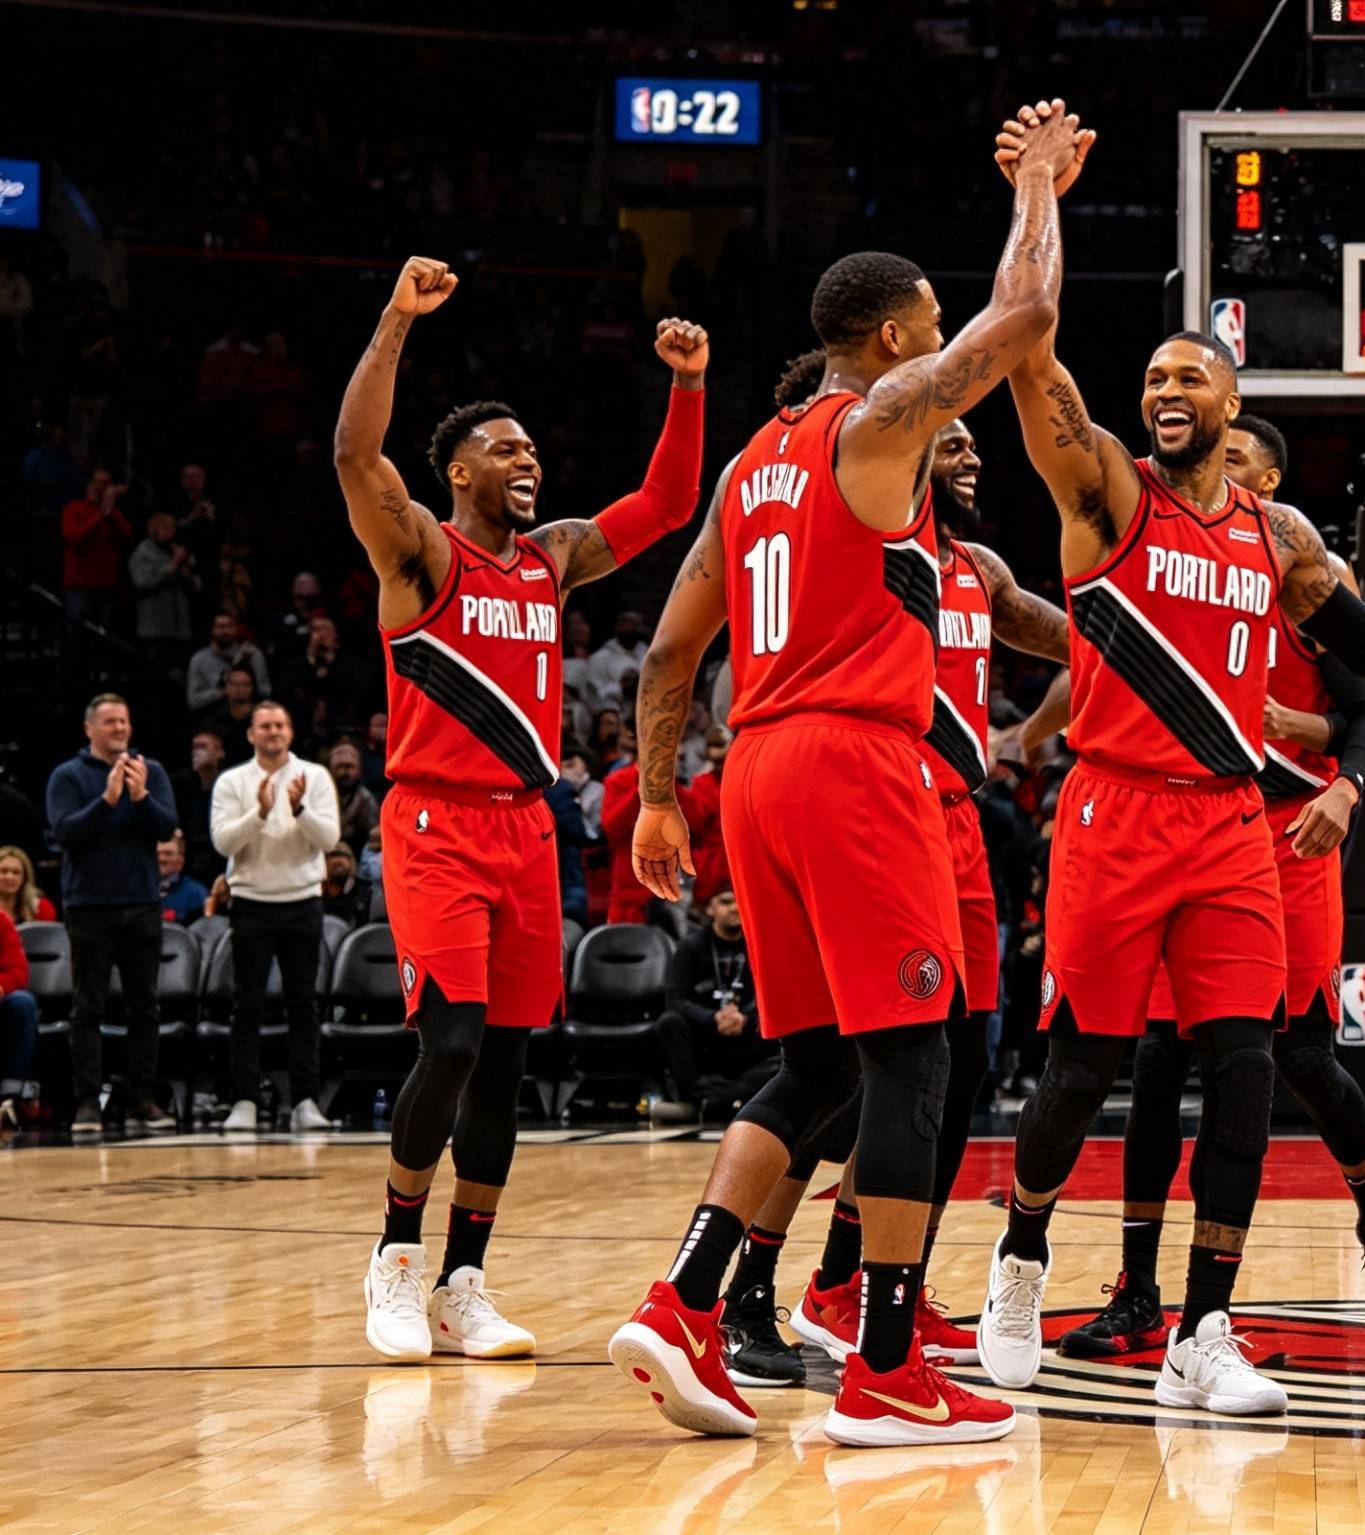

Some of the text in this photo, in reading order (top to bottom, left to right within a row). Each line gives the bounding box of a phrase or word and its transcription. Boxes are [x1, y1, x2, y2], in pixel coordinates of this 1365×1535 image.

[652, 89, 741, 135] 0:22
[744, 532, 791, 656] 10
[1227, 620, 1250, 676] 0
